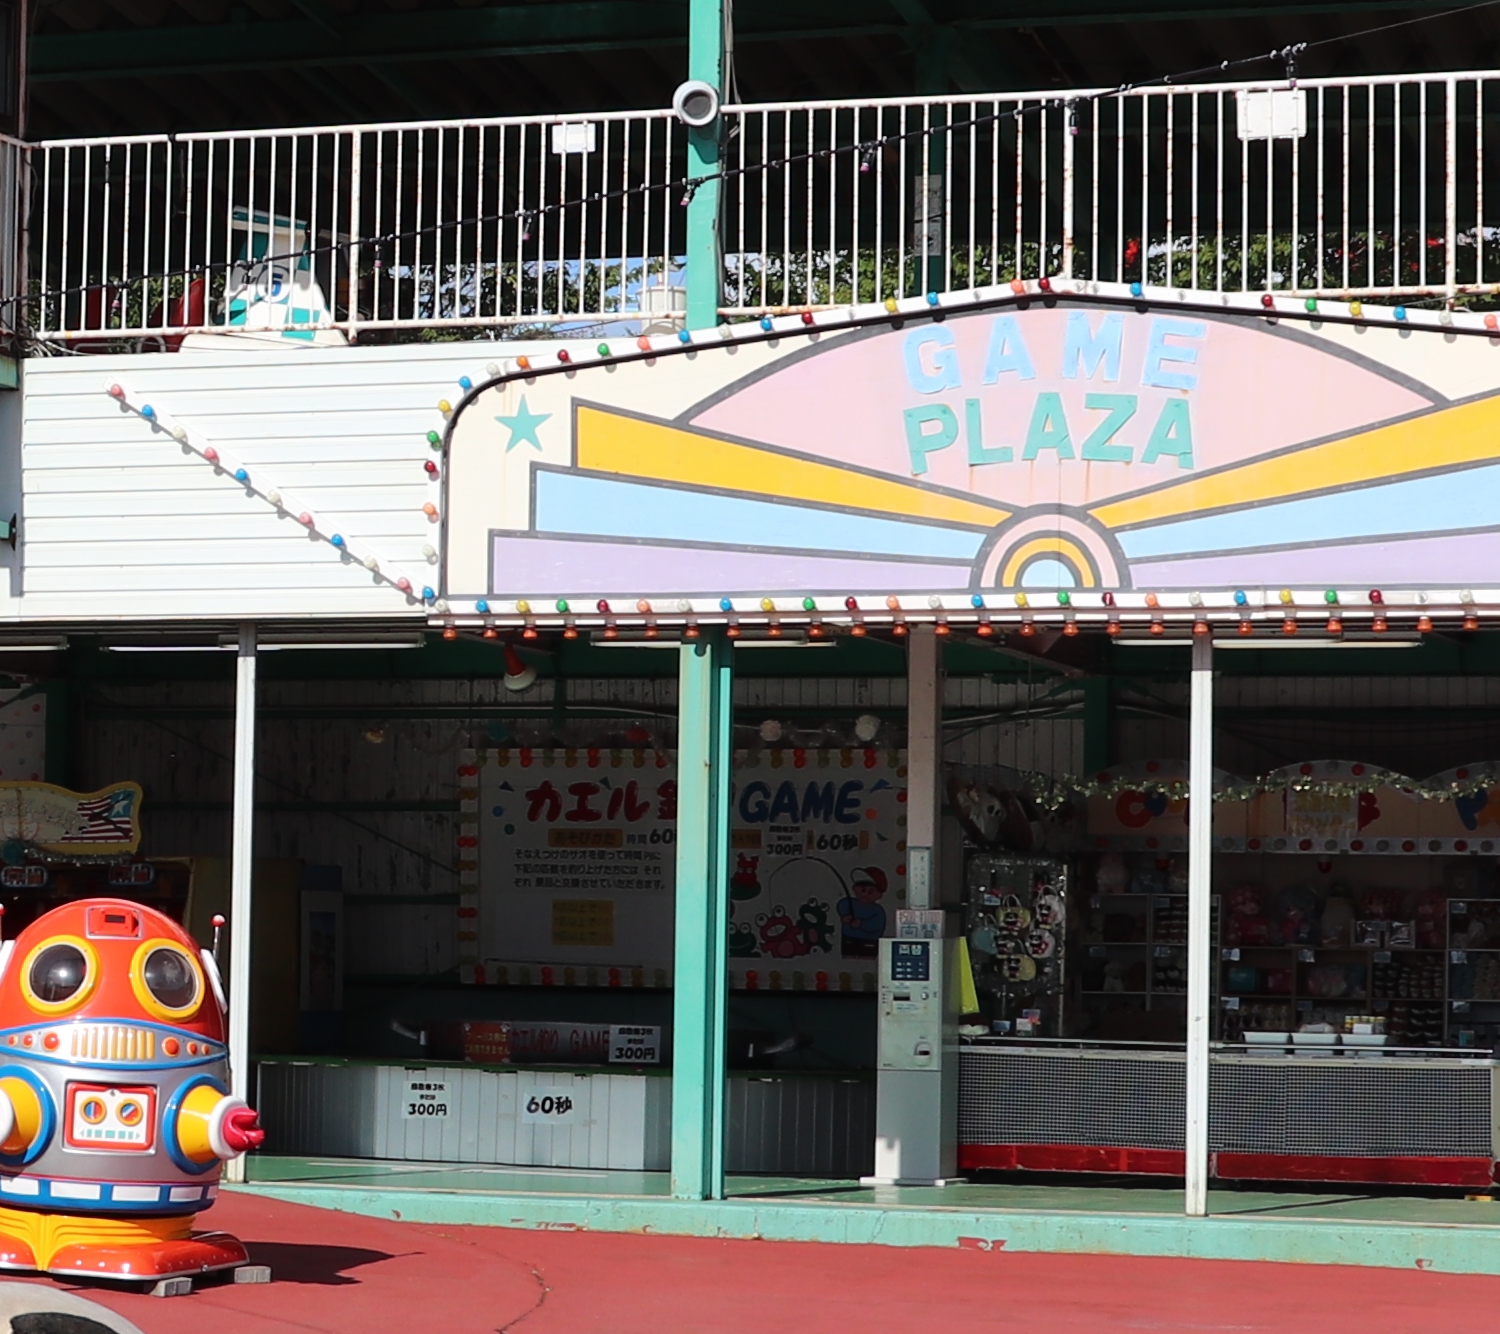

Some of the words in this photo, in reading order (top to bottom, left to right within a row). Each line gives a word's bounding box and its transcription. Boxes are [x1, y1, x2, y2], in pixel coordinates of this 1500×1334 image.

[902, 312, 1206, 394] GAME
[902, 392, 1194, 475] PLAZA
[739, 780, 864, 823] GAME
[766, 843, 803, 855] 300円
[816, 833, 859, 851] 60秒
[615, 1047, 655, 1060] 300円
[408, 1103, 448, 1117] 300円
[526, 1096, 573, 1115] 60秒
